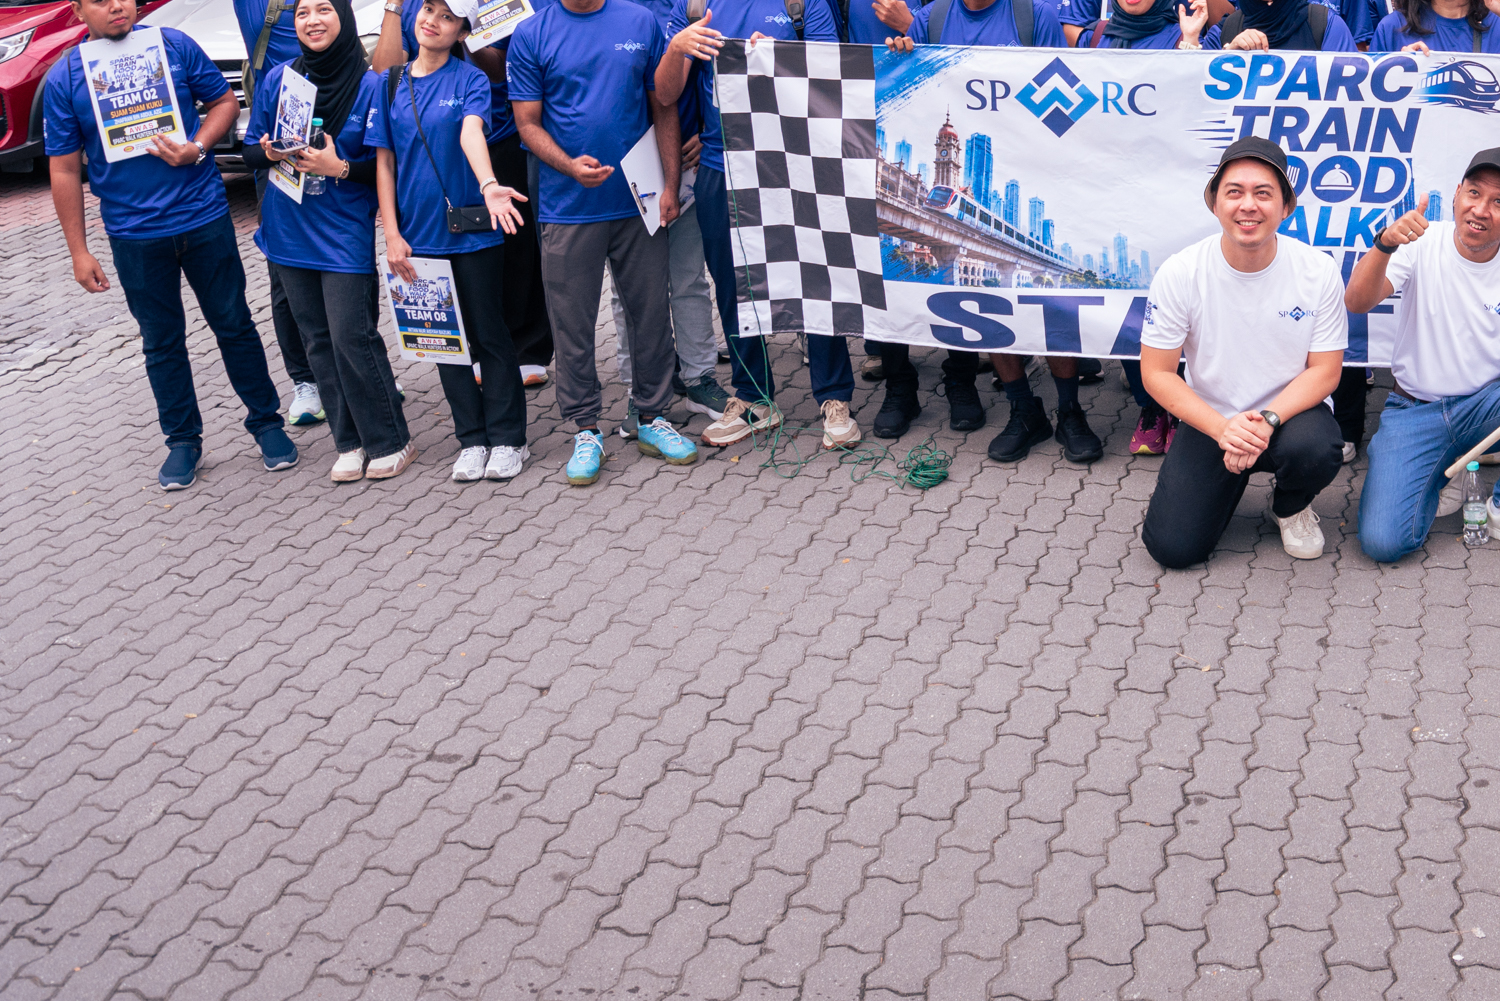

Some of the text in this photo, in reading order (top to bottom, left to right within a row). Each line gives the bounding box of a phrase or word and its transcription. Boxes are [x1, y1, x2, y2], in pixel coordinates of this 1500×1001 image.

[484, 9, 505, 22] AWAS
[110, 56, 134, 65] SPARC
[114, 60, 136, 69] TRAIN
[114, 65, 136, 74] FOOD
[1204, 54, 1418, 102] SPARC
[110, 88, 158, 109] TEAM 02
[110, 100, 162, 118] SUAM SUAM KUKU
[129, 123, 154, 133] AWAS
[1232, 106, 1422, 153] TRAIN
[1278, 206, 1387, 248] ALK
[405, 310, 447, 322] TEAM 08
